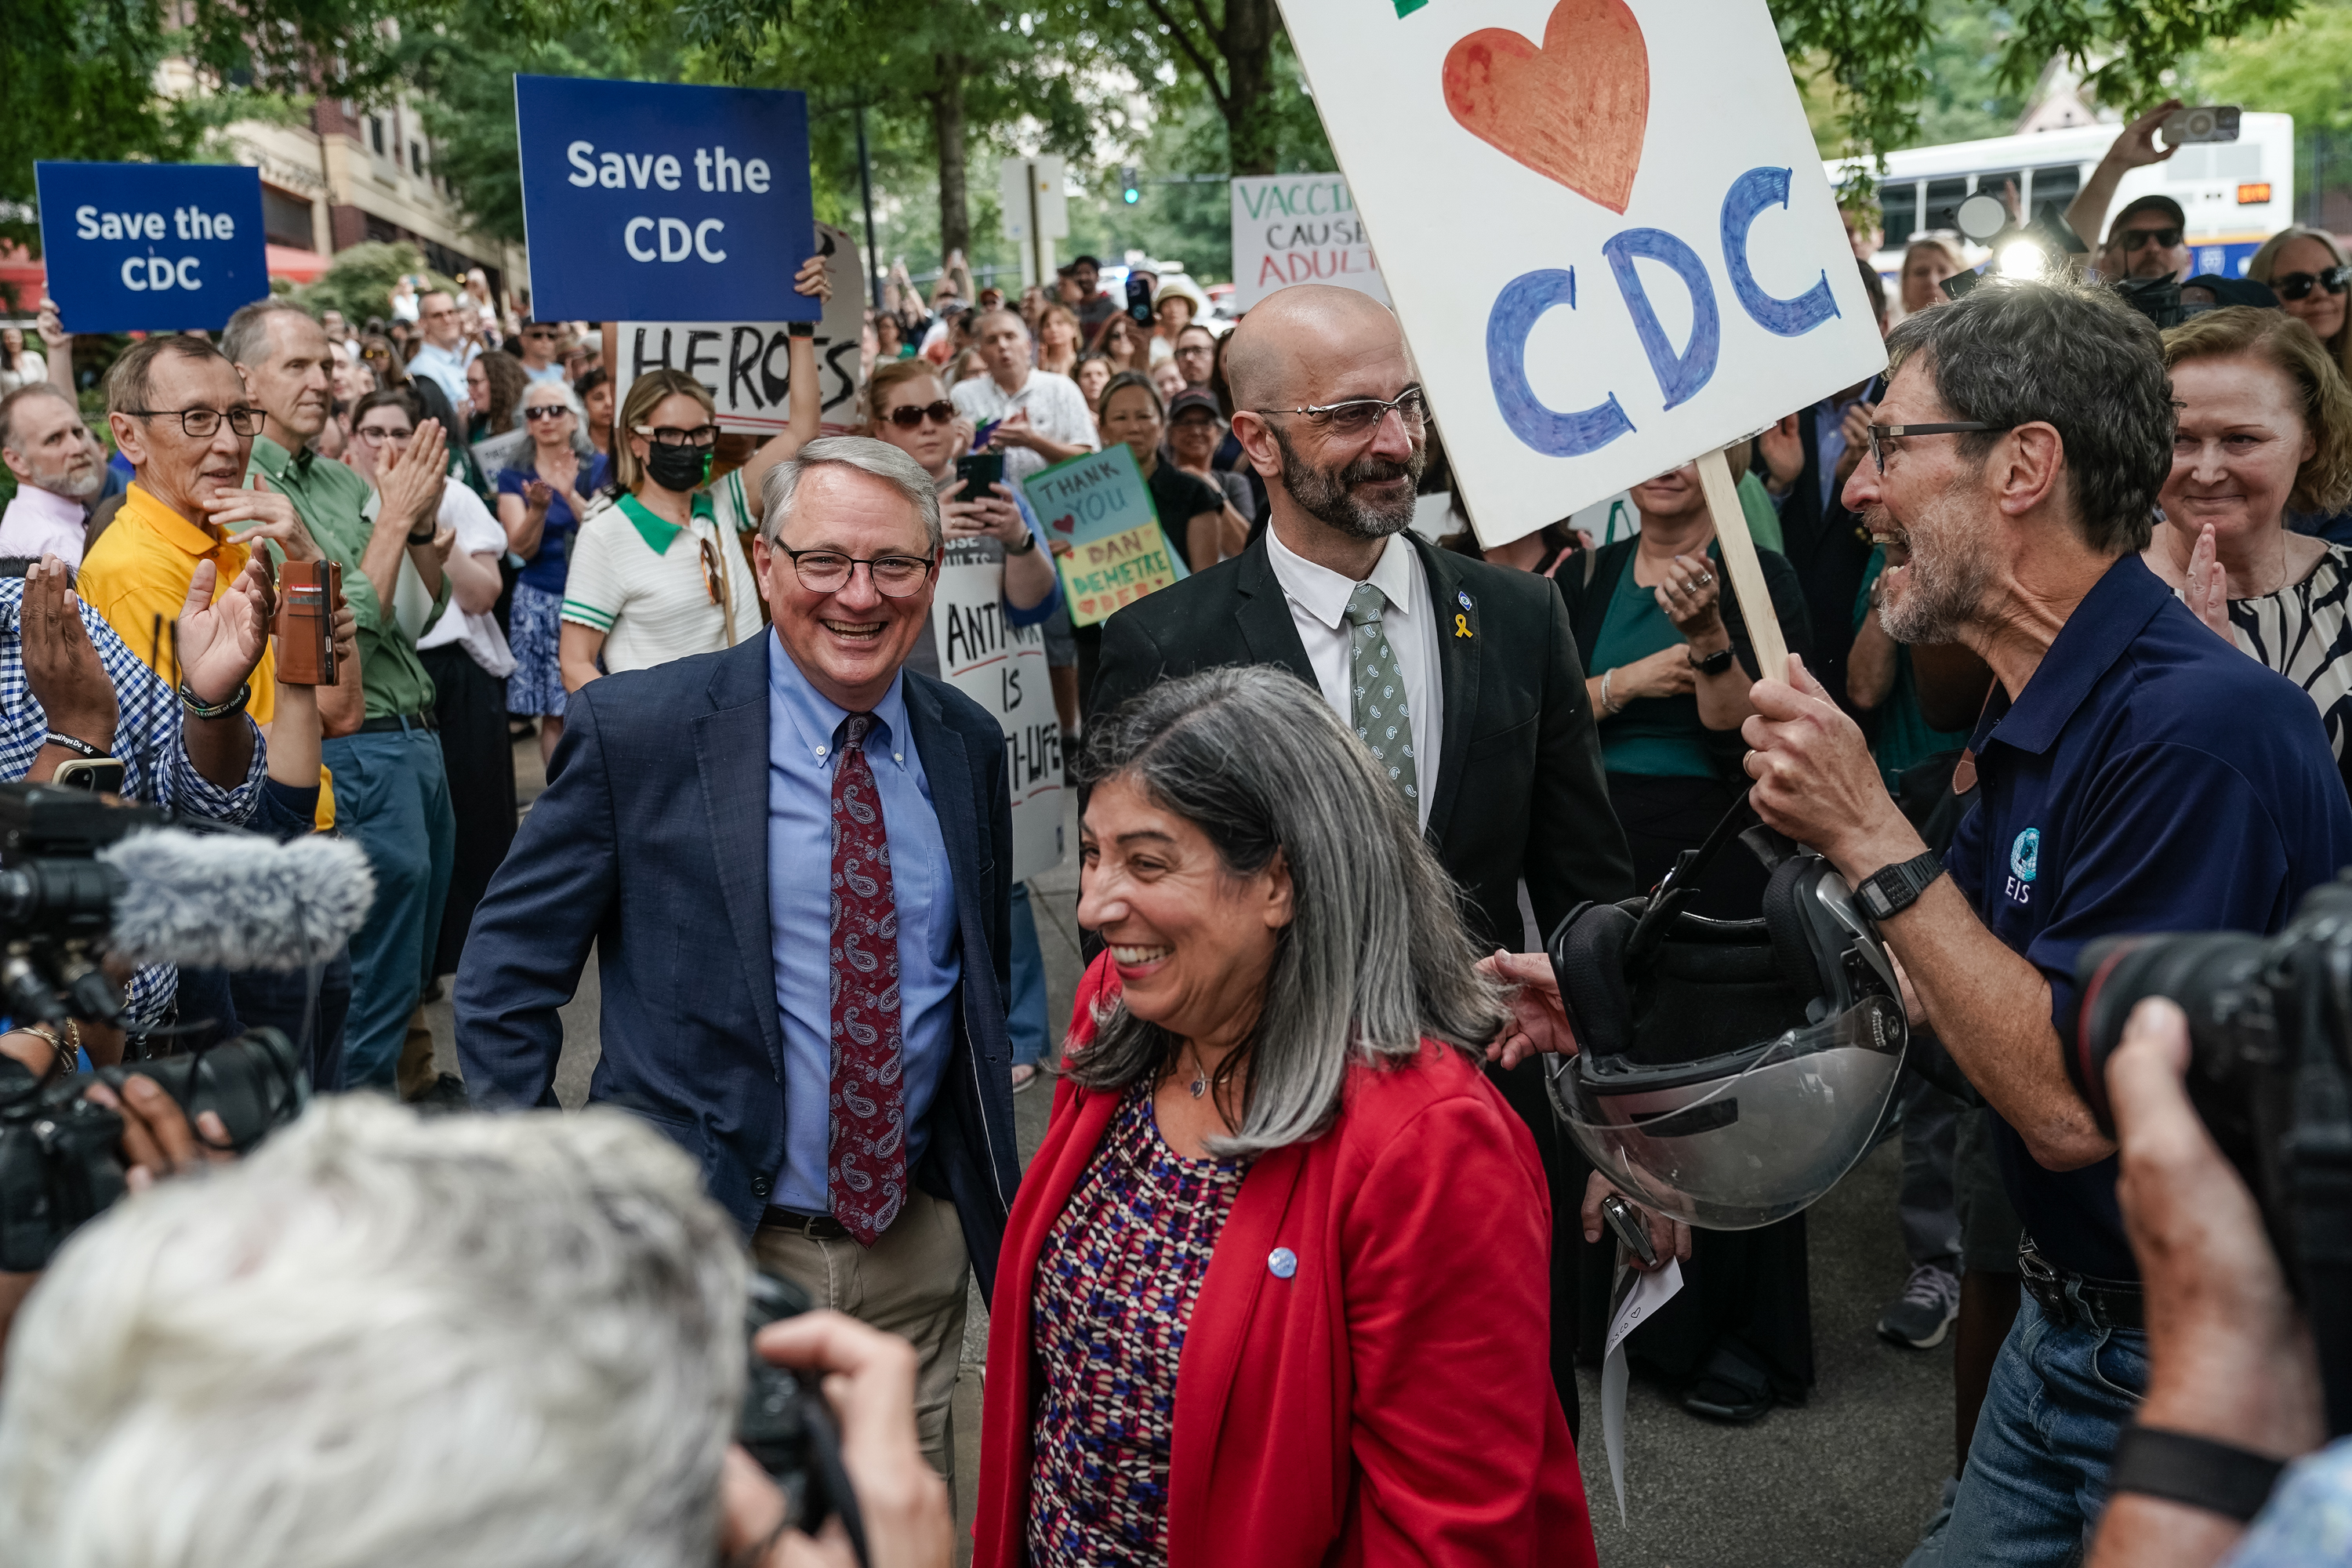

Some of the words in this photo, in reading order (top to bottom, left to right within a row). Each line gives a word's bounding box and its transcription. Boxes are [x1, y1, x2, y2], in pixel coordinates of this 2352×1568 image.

[566, 140, 682, 191] Save
[694, 146, 771, 194] the
[75, 205, 166, 240] Save
[173, 205, 235, 241] the
[624, 216, 728, 264] CDC
[121, 256, 202, 291] CDC
[1486, 166, 1842, 458] CDC
[1038, 461, 1121, 503] THANK
[1065, 488, 1129, 525] YOU
[1087, 532, 1142, 564] DAN
[1072, 551, 1168, 596] DEMETRE
[200, 708, 222, 717] Friend
[230, 694, 241, 707] God
[1002, 667, 1022, 713] IS
[73, 739, 82, 748] Do
[2005, 876, 2031, 904] EIS
